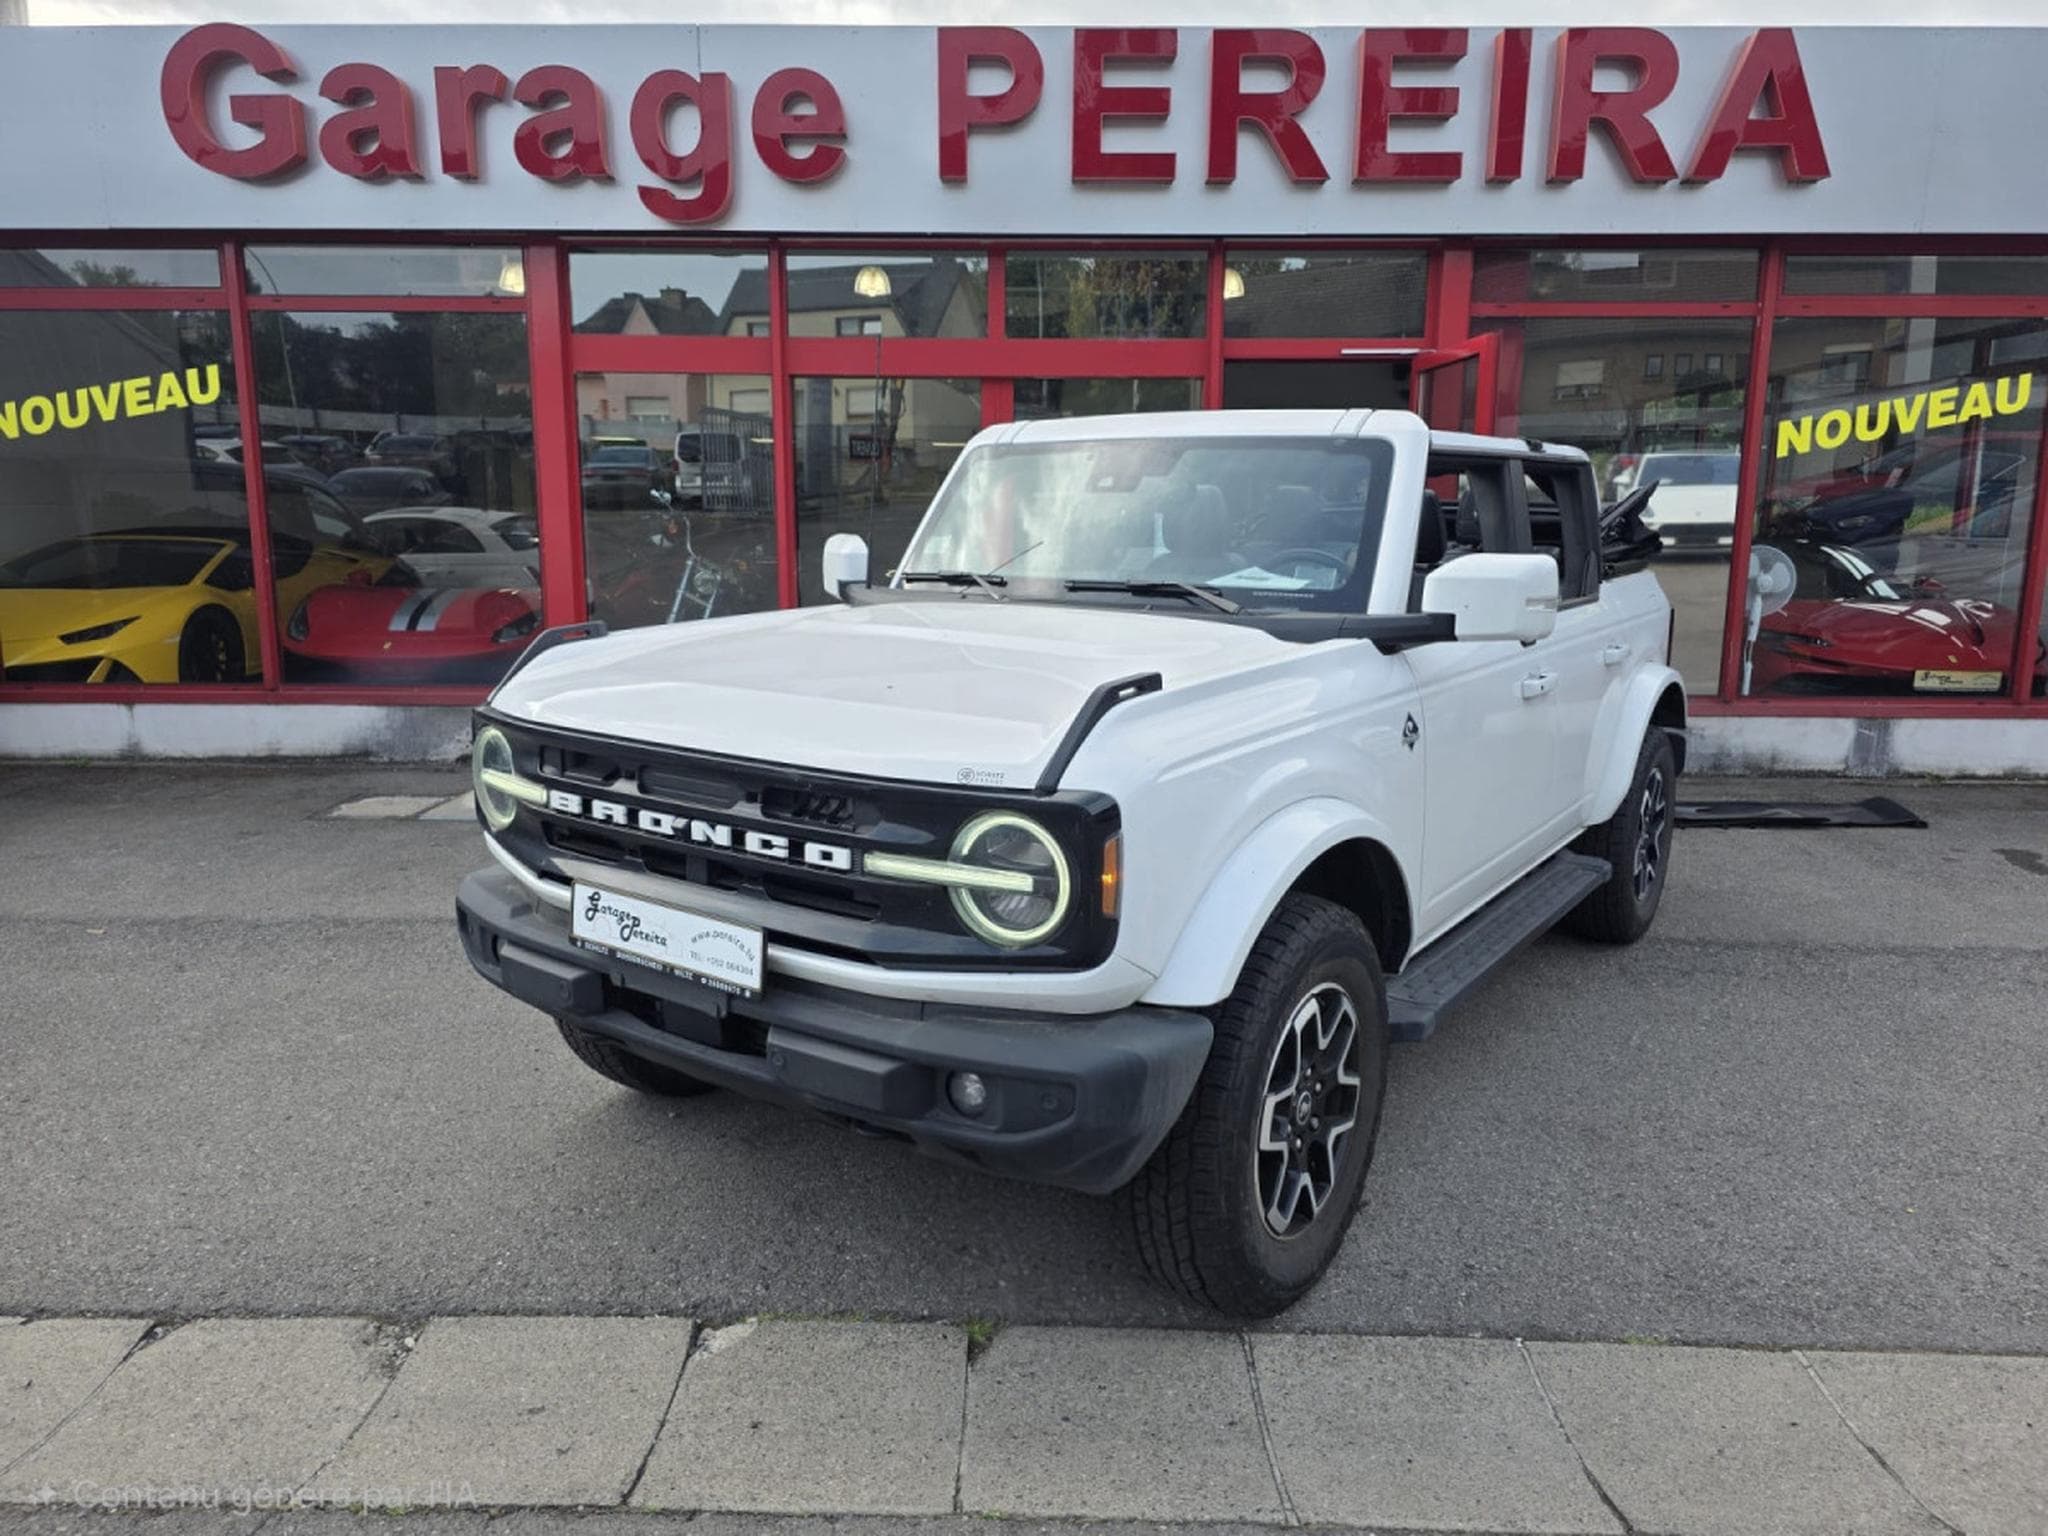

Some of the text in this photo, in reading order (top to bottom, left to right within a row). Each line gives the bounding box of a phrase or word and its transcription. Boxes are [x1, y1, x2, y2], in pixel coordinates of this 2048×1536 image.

[161, 22, 1831, 223] Garage PEREIRA
[1776, 373, 2033, 458] NOUVEAU
[550, 789, 851, 870] BRONCO
[585, 891, 632, 926] Garage
[620, 916, 667, 947] Pereira
